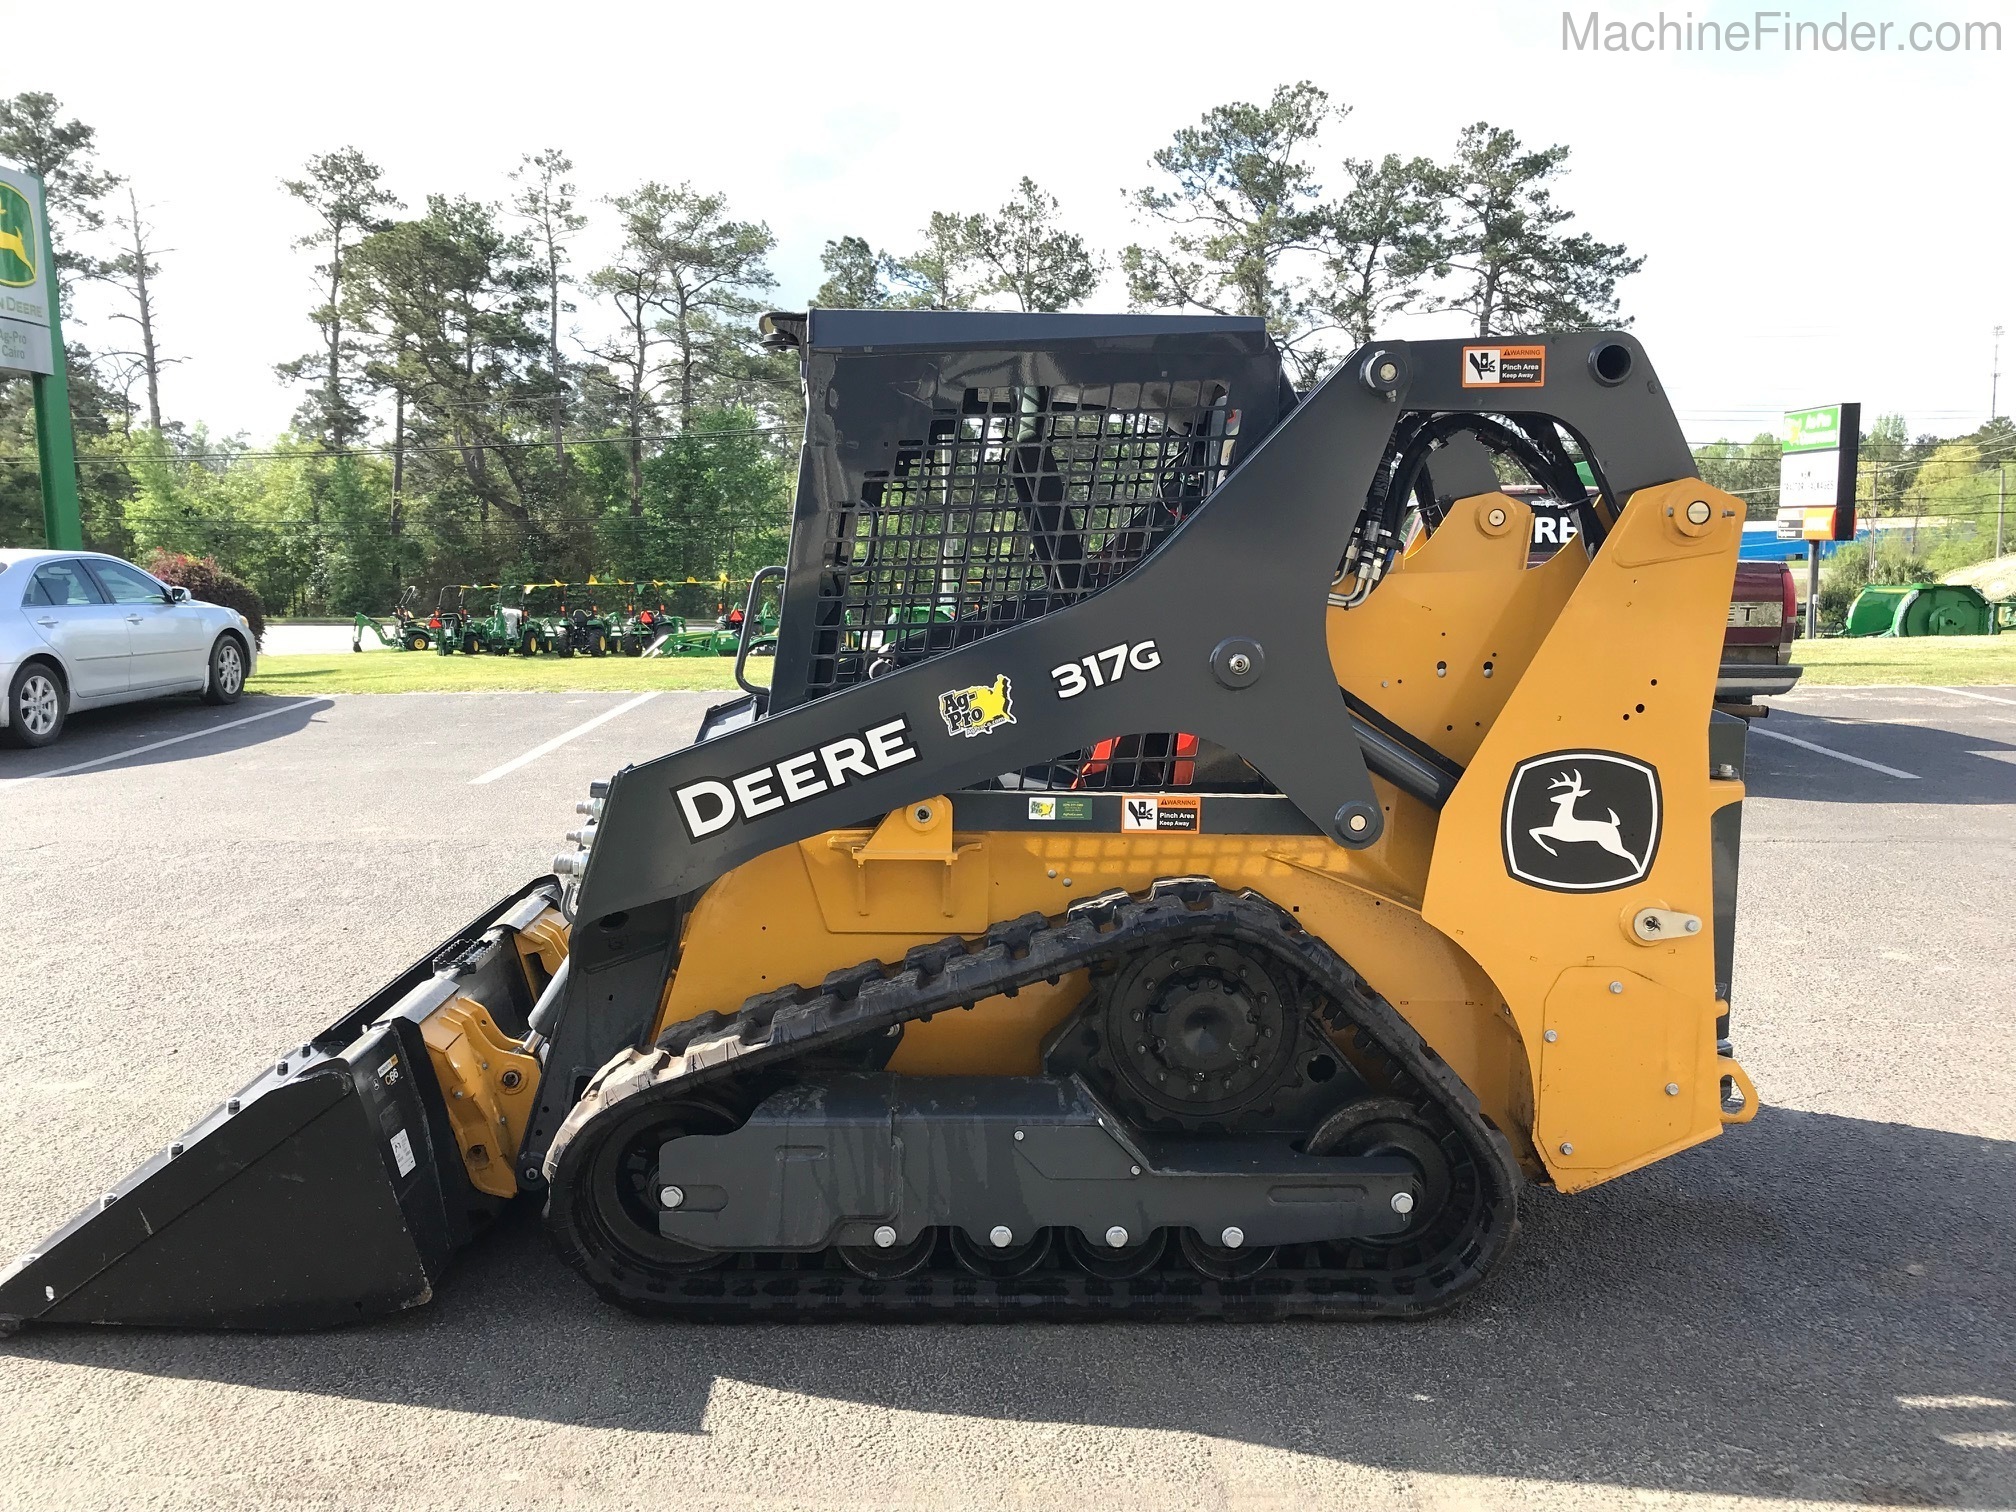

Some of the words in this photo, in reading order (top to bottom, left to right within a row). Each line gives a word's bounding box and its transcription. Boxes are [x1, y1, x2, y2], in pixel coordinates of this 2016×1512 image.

[6, 296, 43, 318] DEERE
[2, 344, 25, 359] Cairo
[1502, 363, 1522, 371] Pinch
[1502, 372, 1517, 380] Keep
[1052, 640, 1161, 699] 317G
[943, 692, 977, 714] Ag-
[947, 708, 983, 731] Pro
[676, 718, 917, 839] DEERE
[385, 1067, 399, 1085] C66
